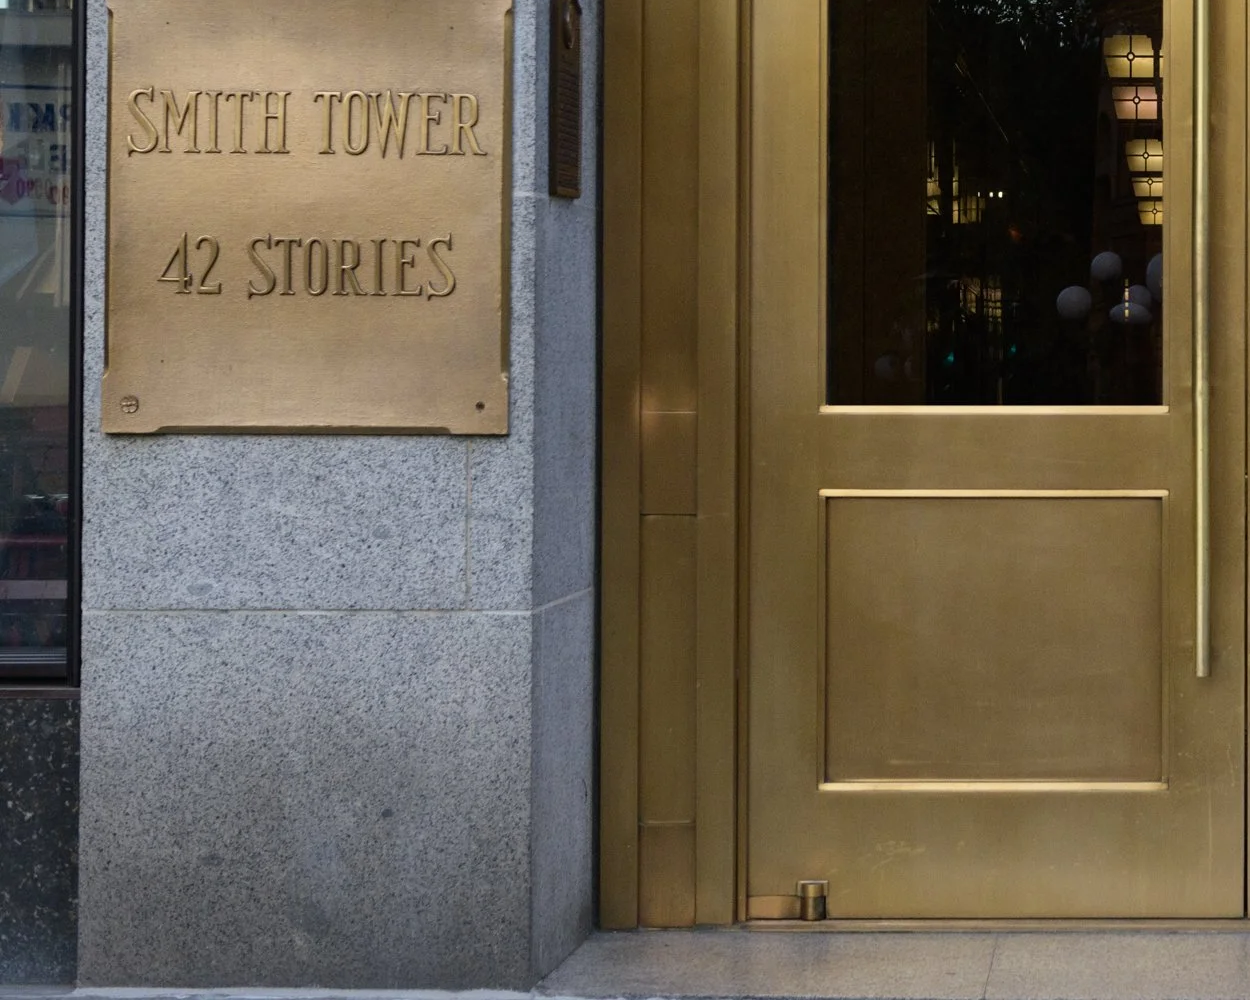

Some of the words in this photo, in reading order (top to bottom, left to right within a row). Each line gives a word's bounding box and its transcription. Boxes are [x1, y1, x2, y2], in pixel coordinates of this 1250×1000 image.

[126, 86, 292, 157] SMITH
[313, 88, 488, 159] TOWER
[157, 231, 223, 296] 42
[246, 231, 457, 301] STORIES
